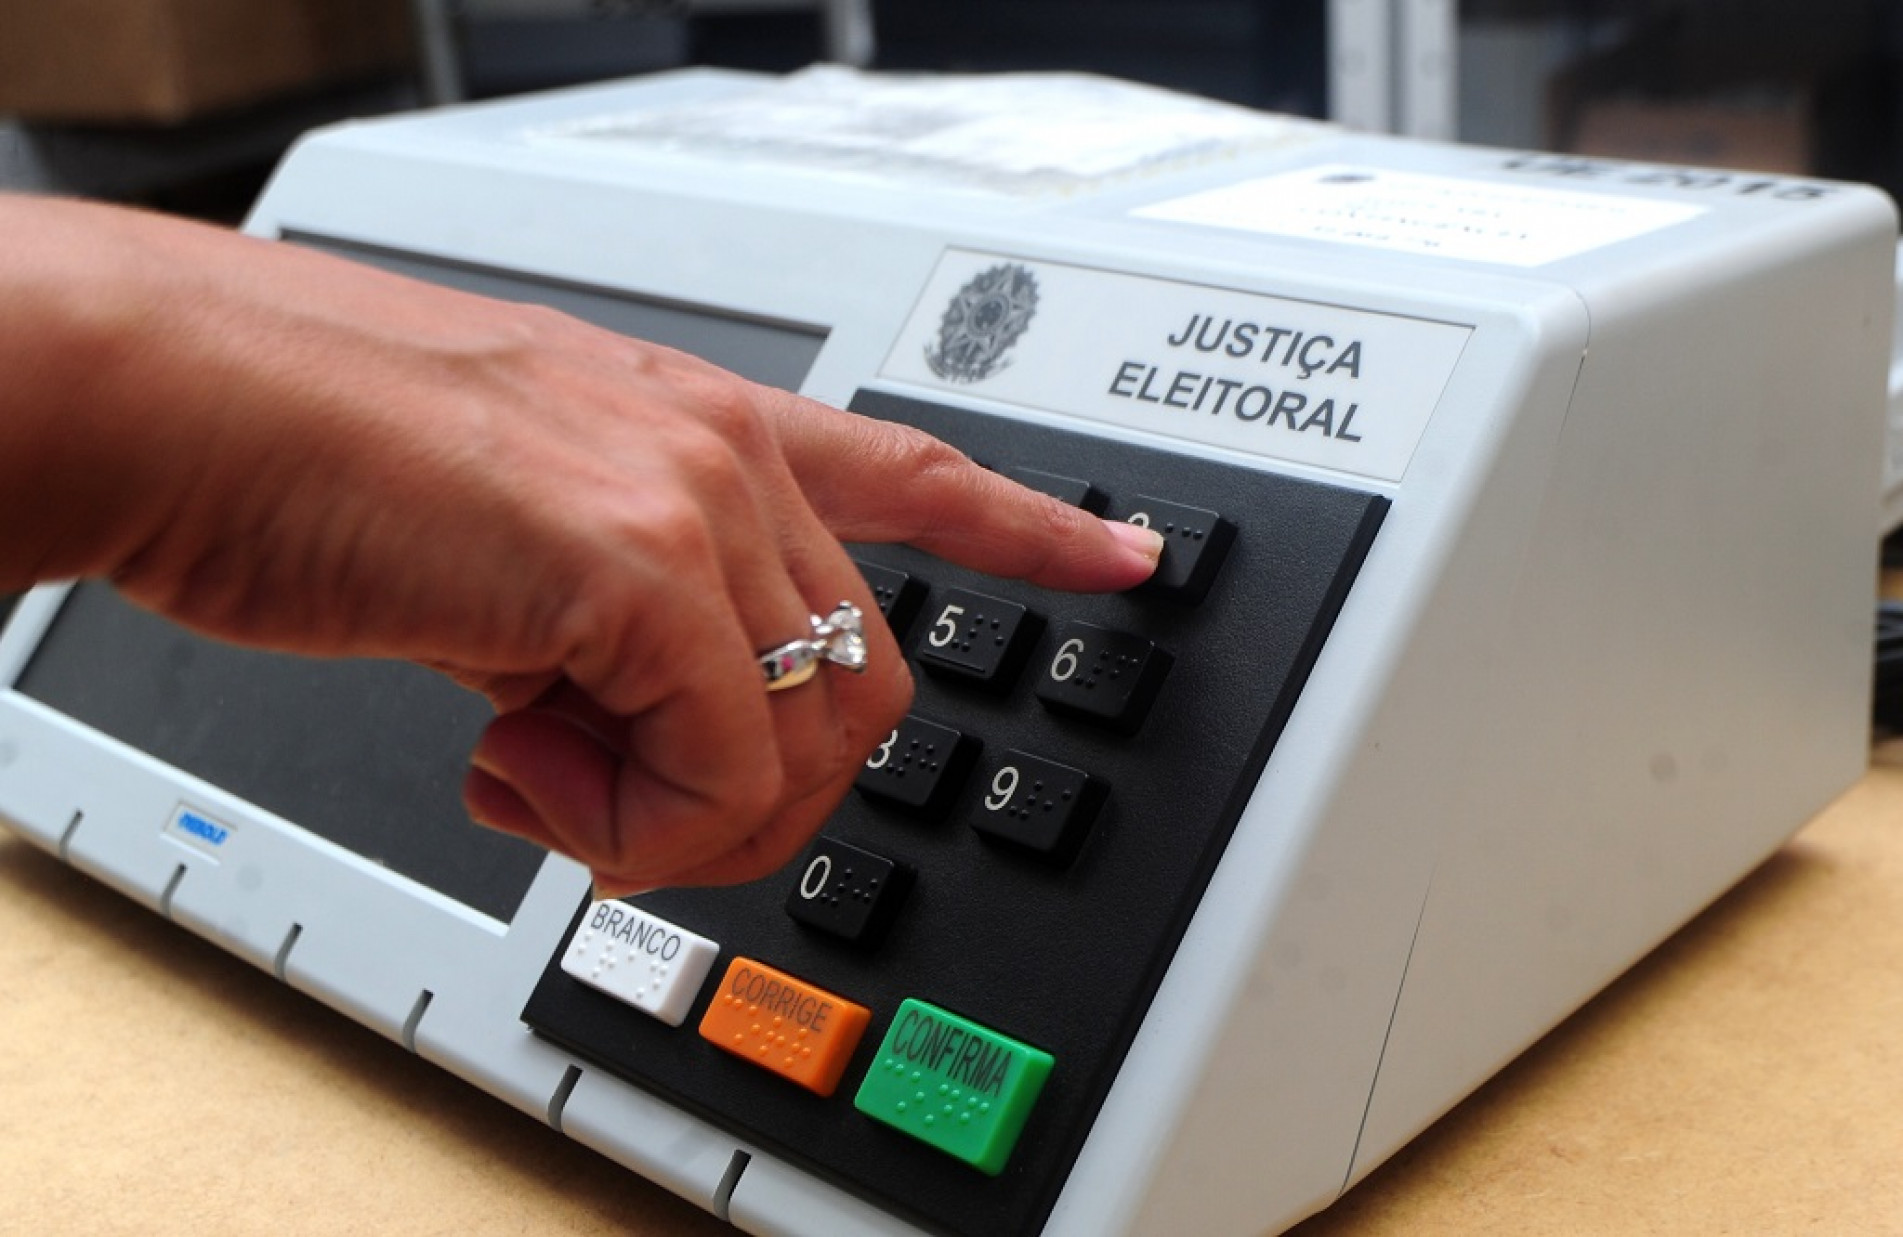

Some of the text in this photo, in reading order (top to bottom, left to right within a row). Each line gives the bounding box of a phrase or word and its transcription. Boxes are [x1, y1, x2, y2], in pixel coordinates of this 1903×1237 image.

[1168, 316, 1363, 379] JUSTIÇA
[1109, 362, 1363, 442] ELEITORAL
[928, 604, 965, 648] 5
[1050, 638, 1084, 681] 6
[984, 766, 1019, 811] 9
[800, 855, 832, 900] 0
[590, 903, 681, 961] BRANCO
[731, 967, 833, 1032] CORRIGE
[892, 1009, 1012, 1097] CONFIRMA
